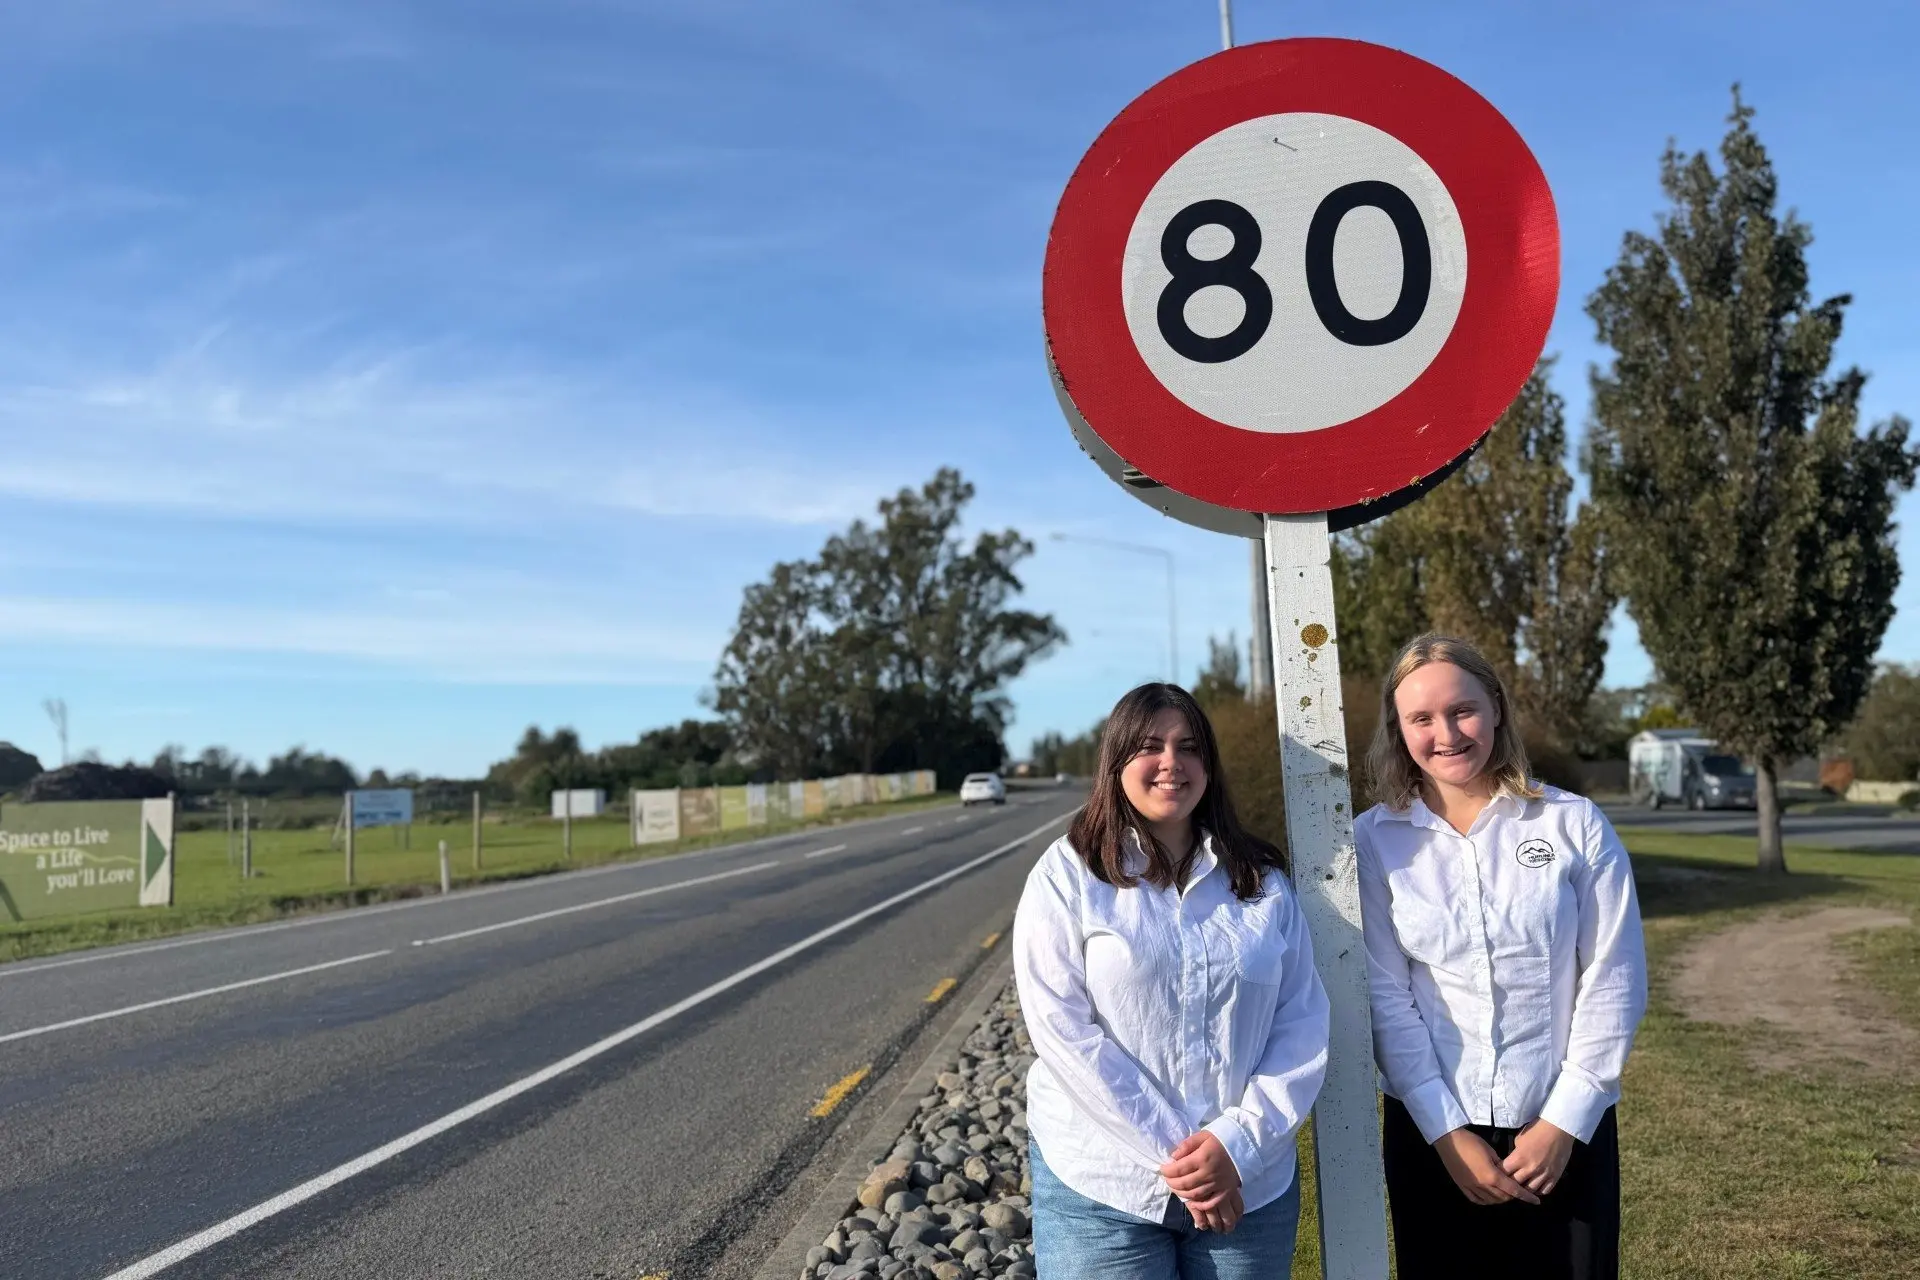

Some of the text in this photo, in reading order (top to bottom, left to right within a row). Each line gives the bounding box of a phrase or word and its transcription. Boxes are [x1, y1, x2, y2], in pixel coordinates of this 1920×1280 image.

[1157, 180, 1431, 363] 80
[0, 826, 109, 853] Space to Live
[36, 849, 83, 870] a Life
[46, 867, 135, 894] you'll Love
